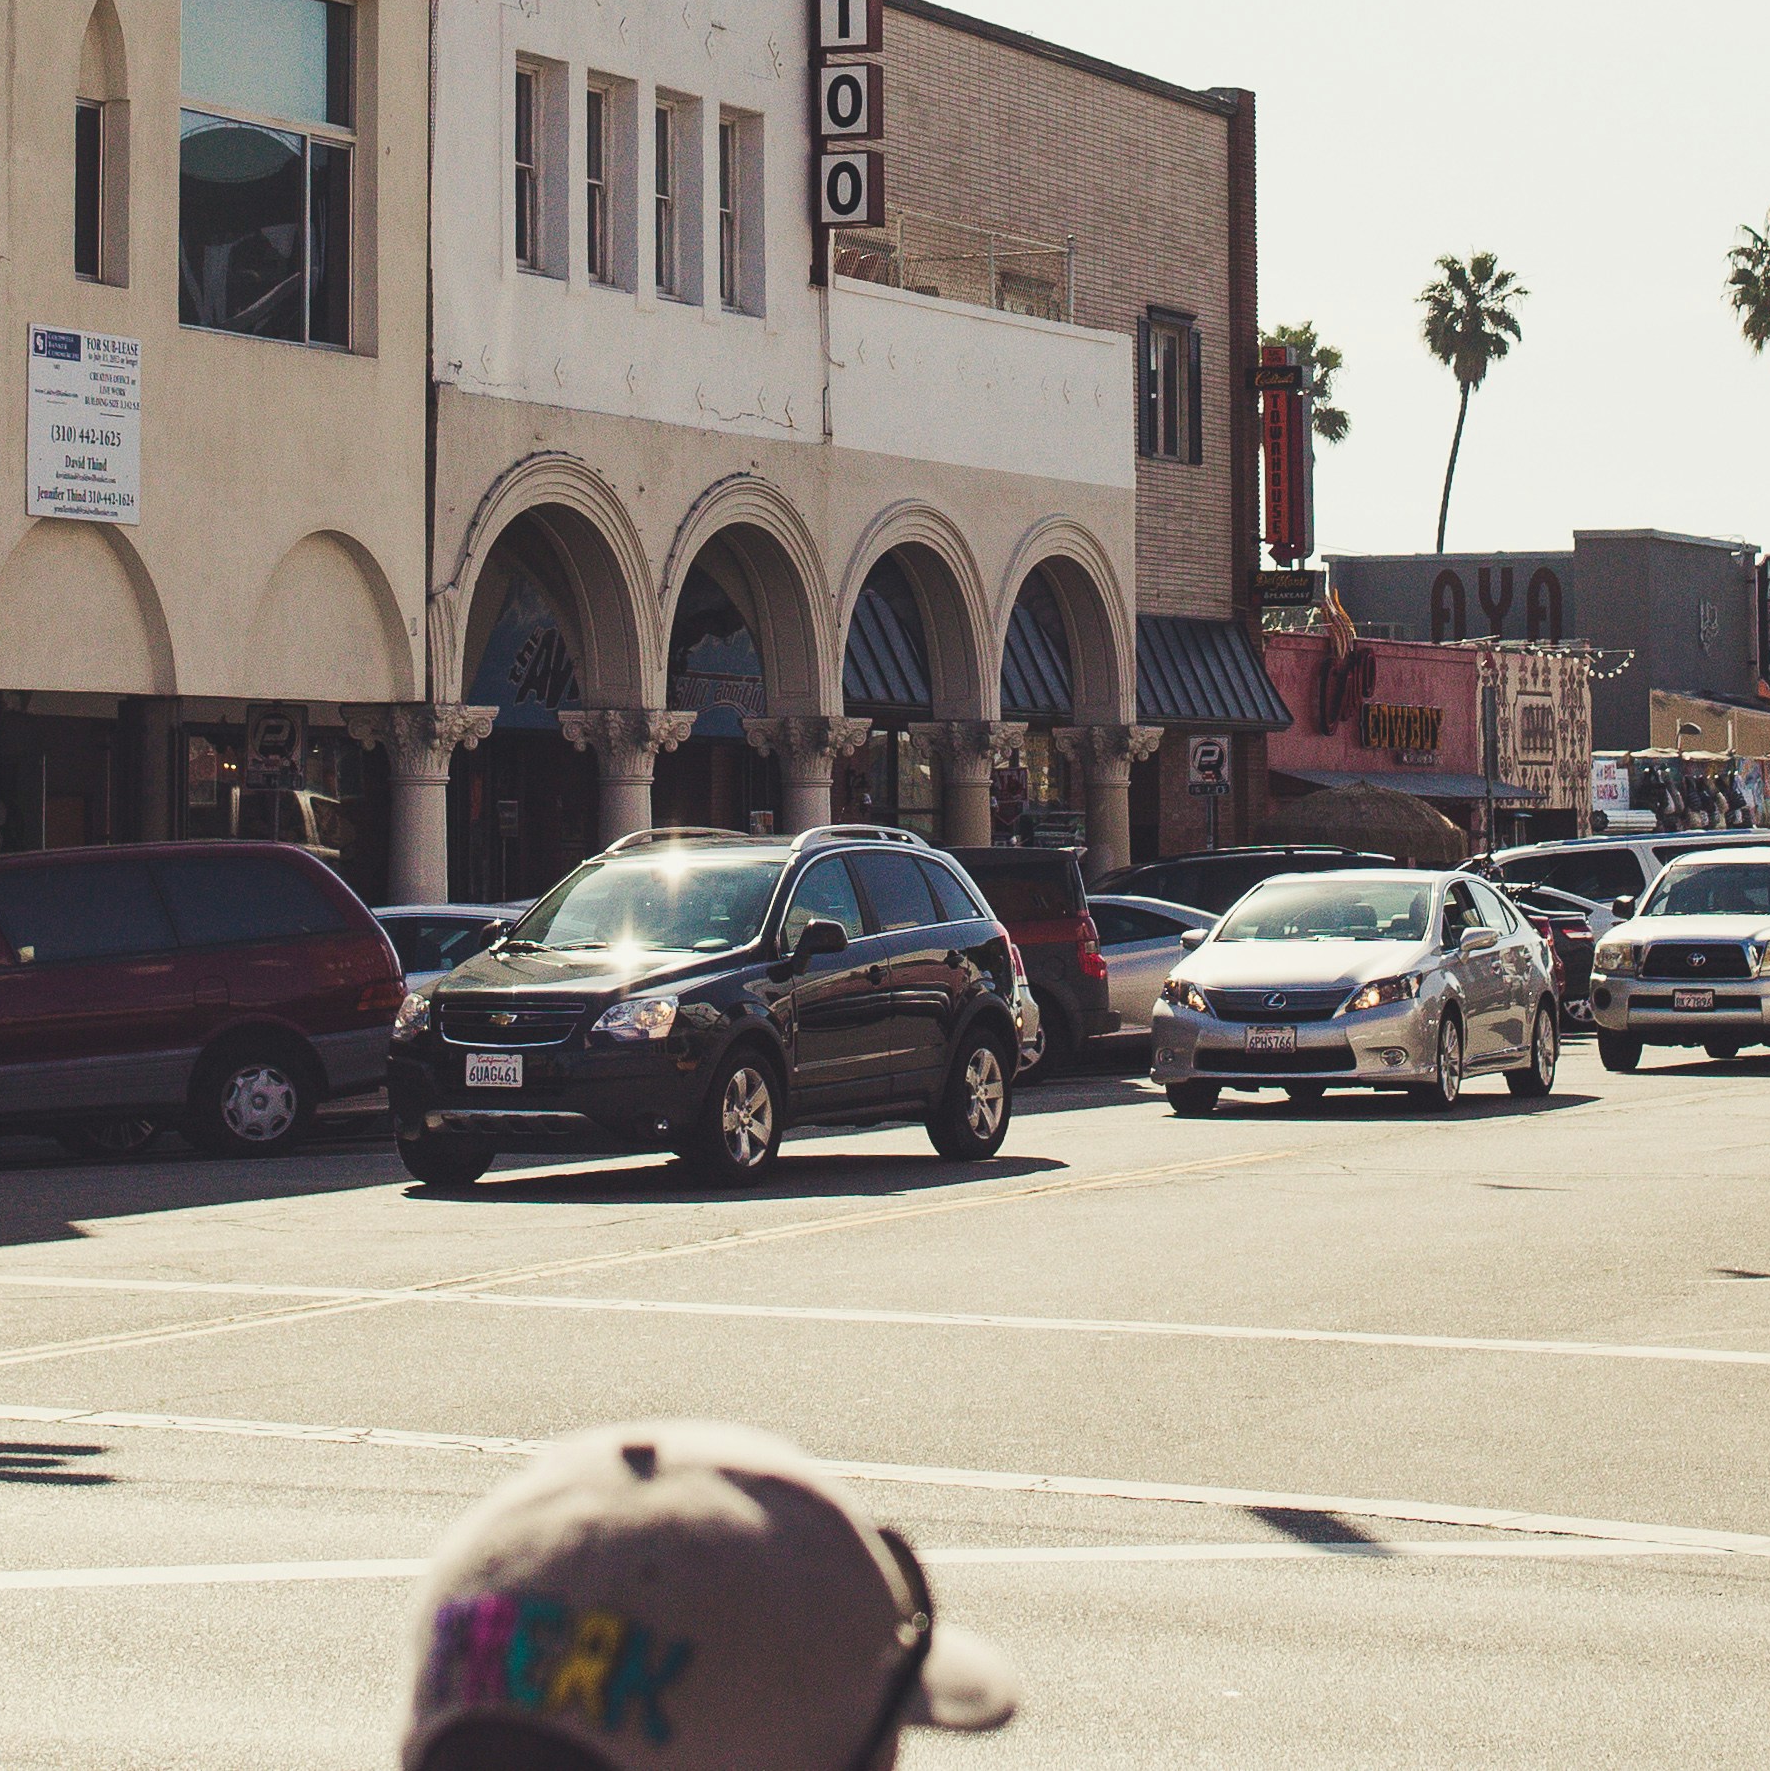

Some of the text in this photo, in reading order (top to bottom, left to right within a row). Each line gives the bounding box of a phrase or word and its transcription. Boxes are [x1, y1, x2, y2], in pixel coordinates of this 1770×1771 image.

[86, 337, 101, 351] FOR
[51, 424, 122, 448] (310) 442-1625
[65, 454, 86, 471] David
[36, 485, 65, 502] Jennifer
[67, 488, 87, 503] Thind
[1431, 567, 1562, 644] AYA
[1368, 702, 1444, 750] COWBOY
[469, 1066, 518, 1083] 6UAG461
